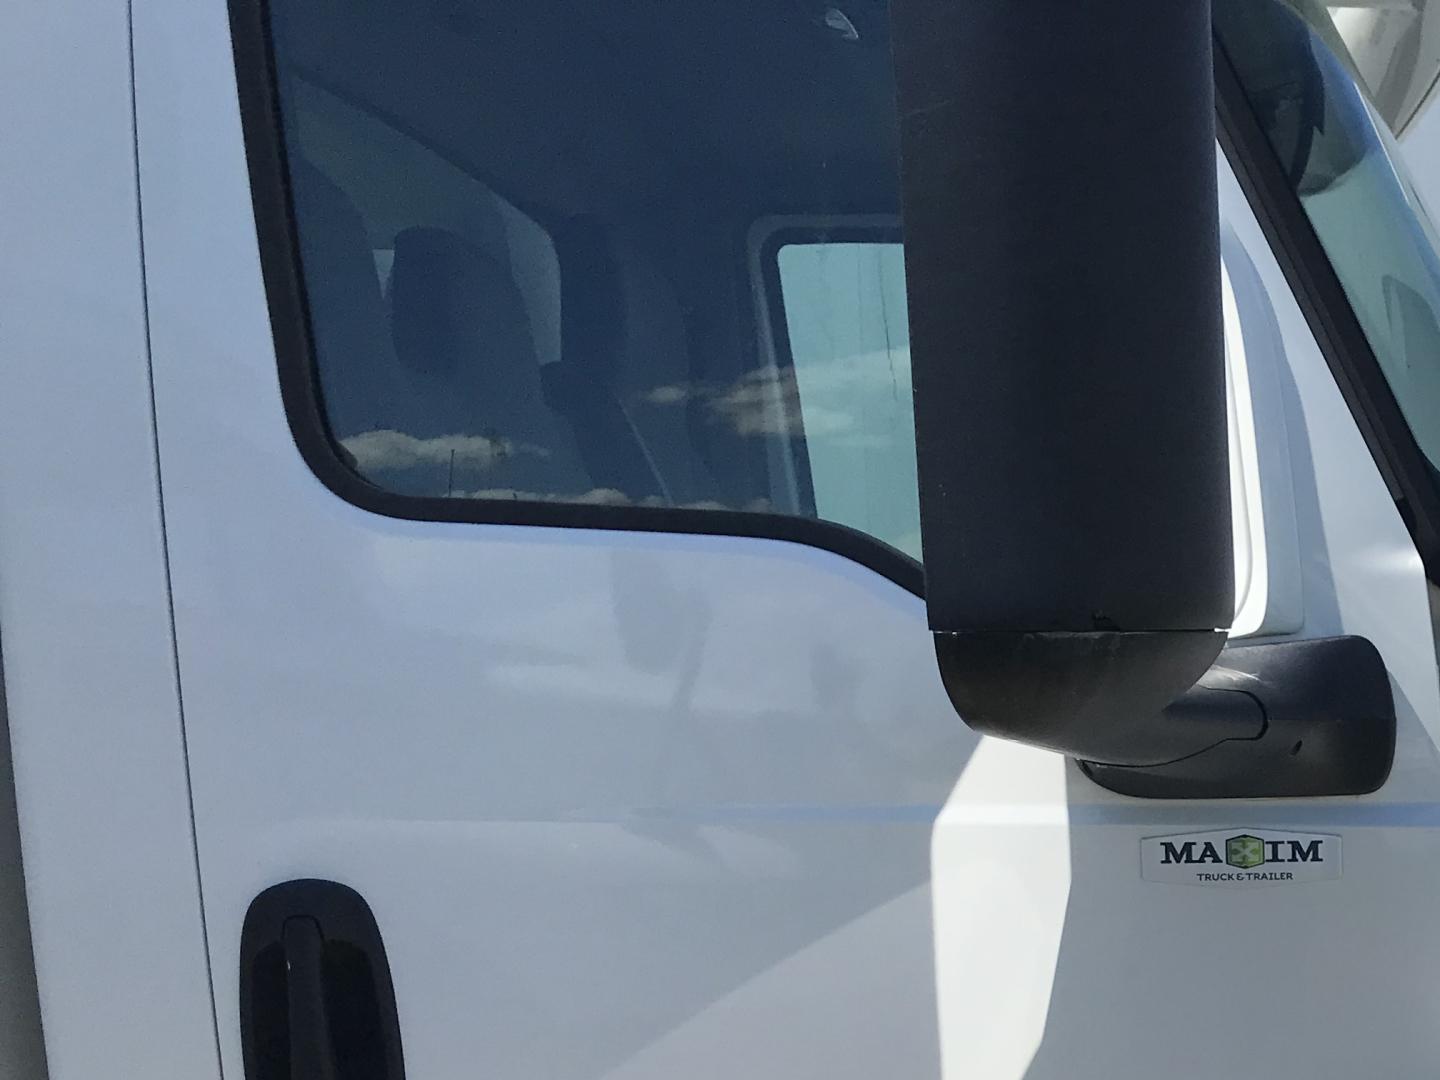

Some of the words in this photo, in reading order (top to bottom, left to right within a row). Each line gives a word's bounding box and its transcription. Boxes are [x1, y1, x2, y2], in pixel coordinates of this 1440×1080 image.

[1160, 836, 1324, 867] MAXIM
[1196, 873, 1235, 881] TRUCK
[1236, 873, 1245, 881] &
[1246, 872, 1294, 881] TRAILER
